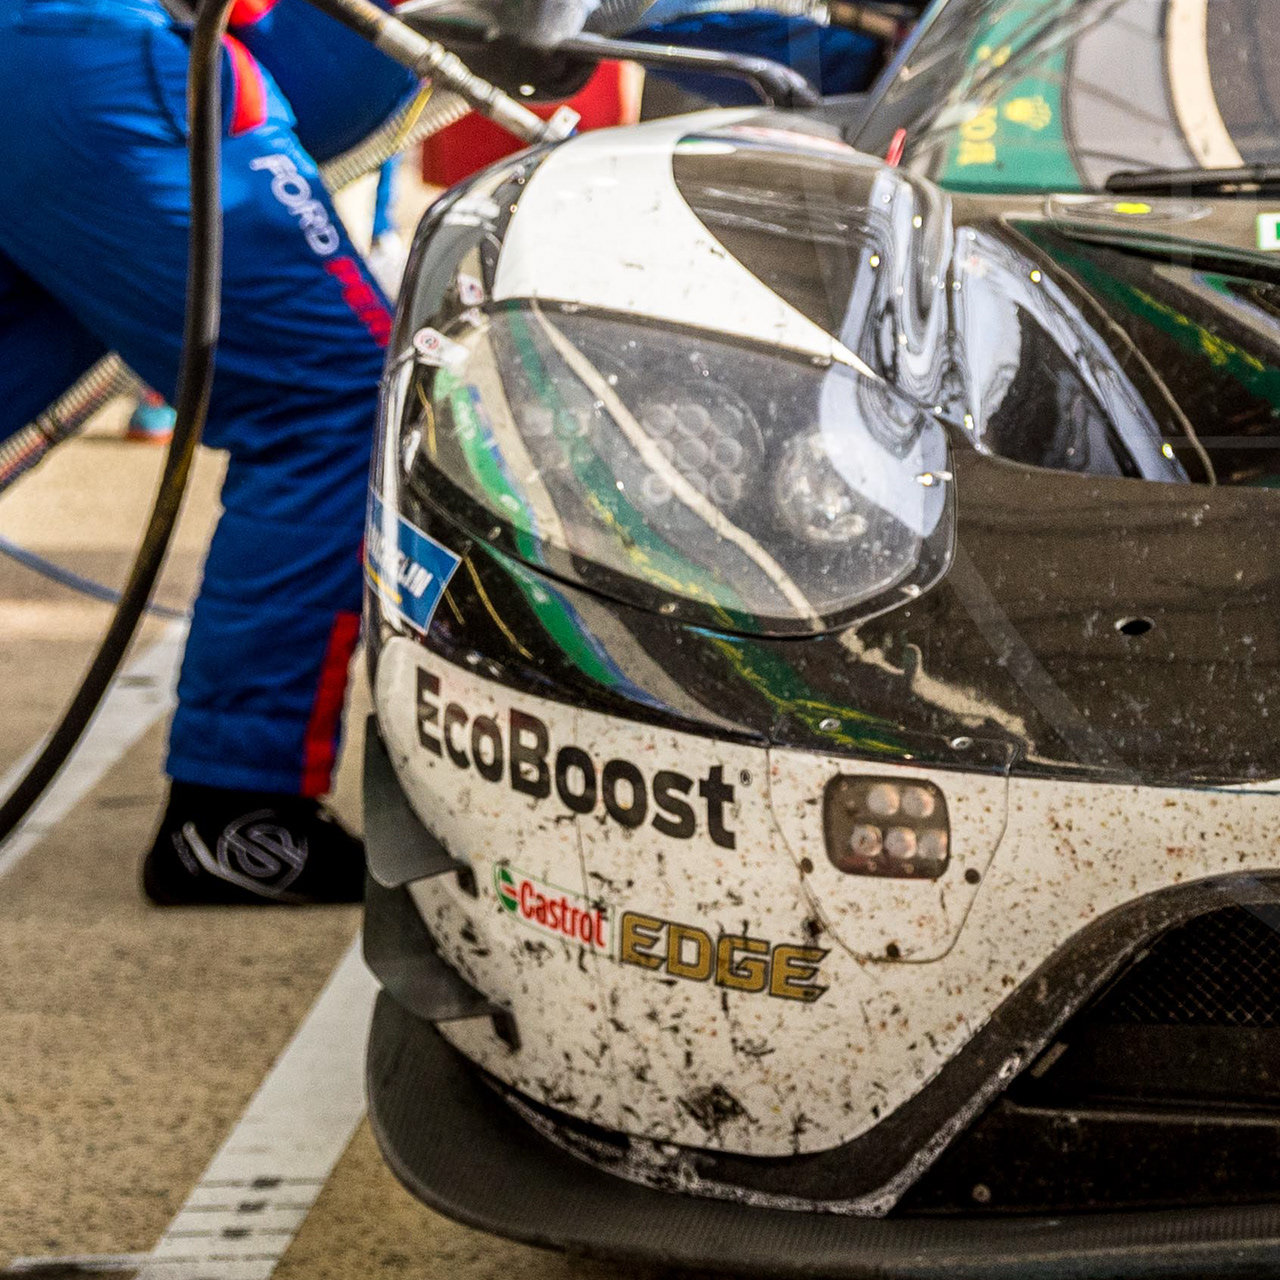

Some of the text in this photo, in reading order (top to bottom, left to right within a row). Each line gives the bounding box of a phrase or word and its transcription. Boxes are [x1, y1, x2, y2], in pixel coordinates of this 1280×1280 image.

[249, 153, 340, 256] FORD
[416, 666, 736, 850] EcoBoost
[519, 878, 606, 948] Castrol
[619, 910, 831, 1004] EDGE
